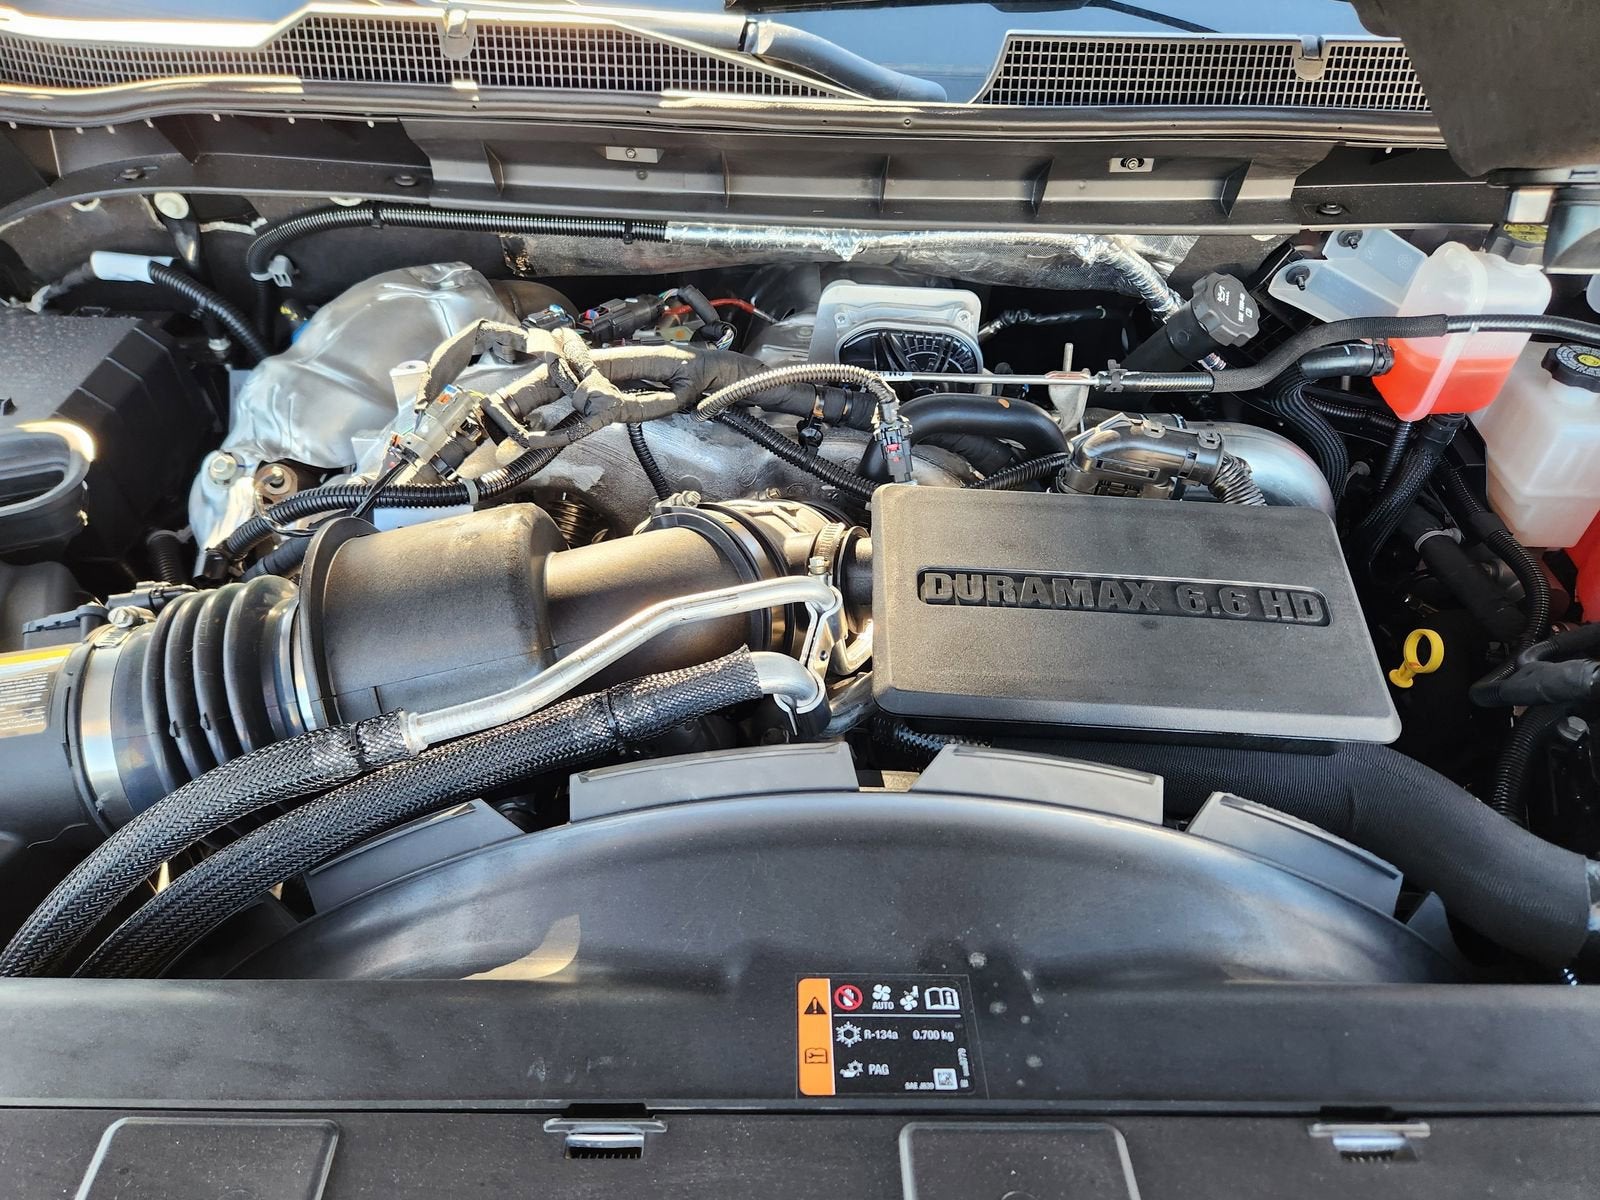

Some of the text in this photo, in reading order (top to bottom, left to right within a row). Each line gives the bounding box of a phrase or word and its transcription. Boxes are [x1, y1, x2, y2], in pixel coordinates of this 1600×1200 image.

[922, 572, 1324, 623] DURAMAX 6.6 HD
[872, 1001, 895, 1010] AUTO
[863, 1029, 955, 1042] R-134a 0.700 kg
[868, 1063, 890, 1075] PAG
